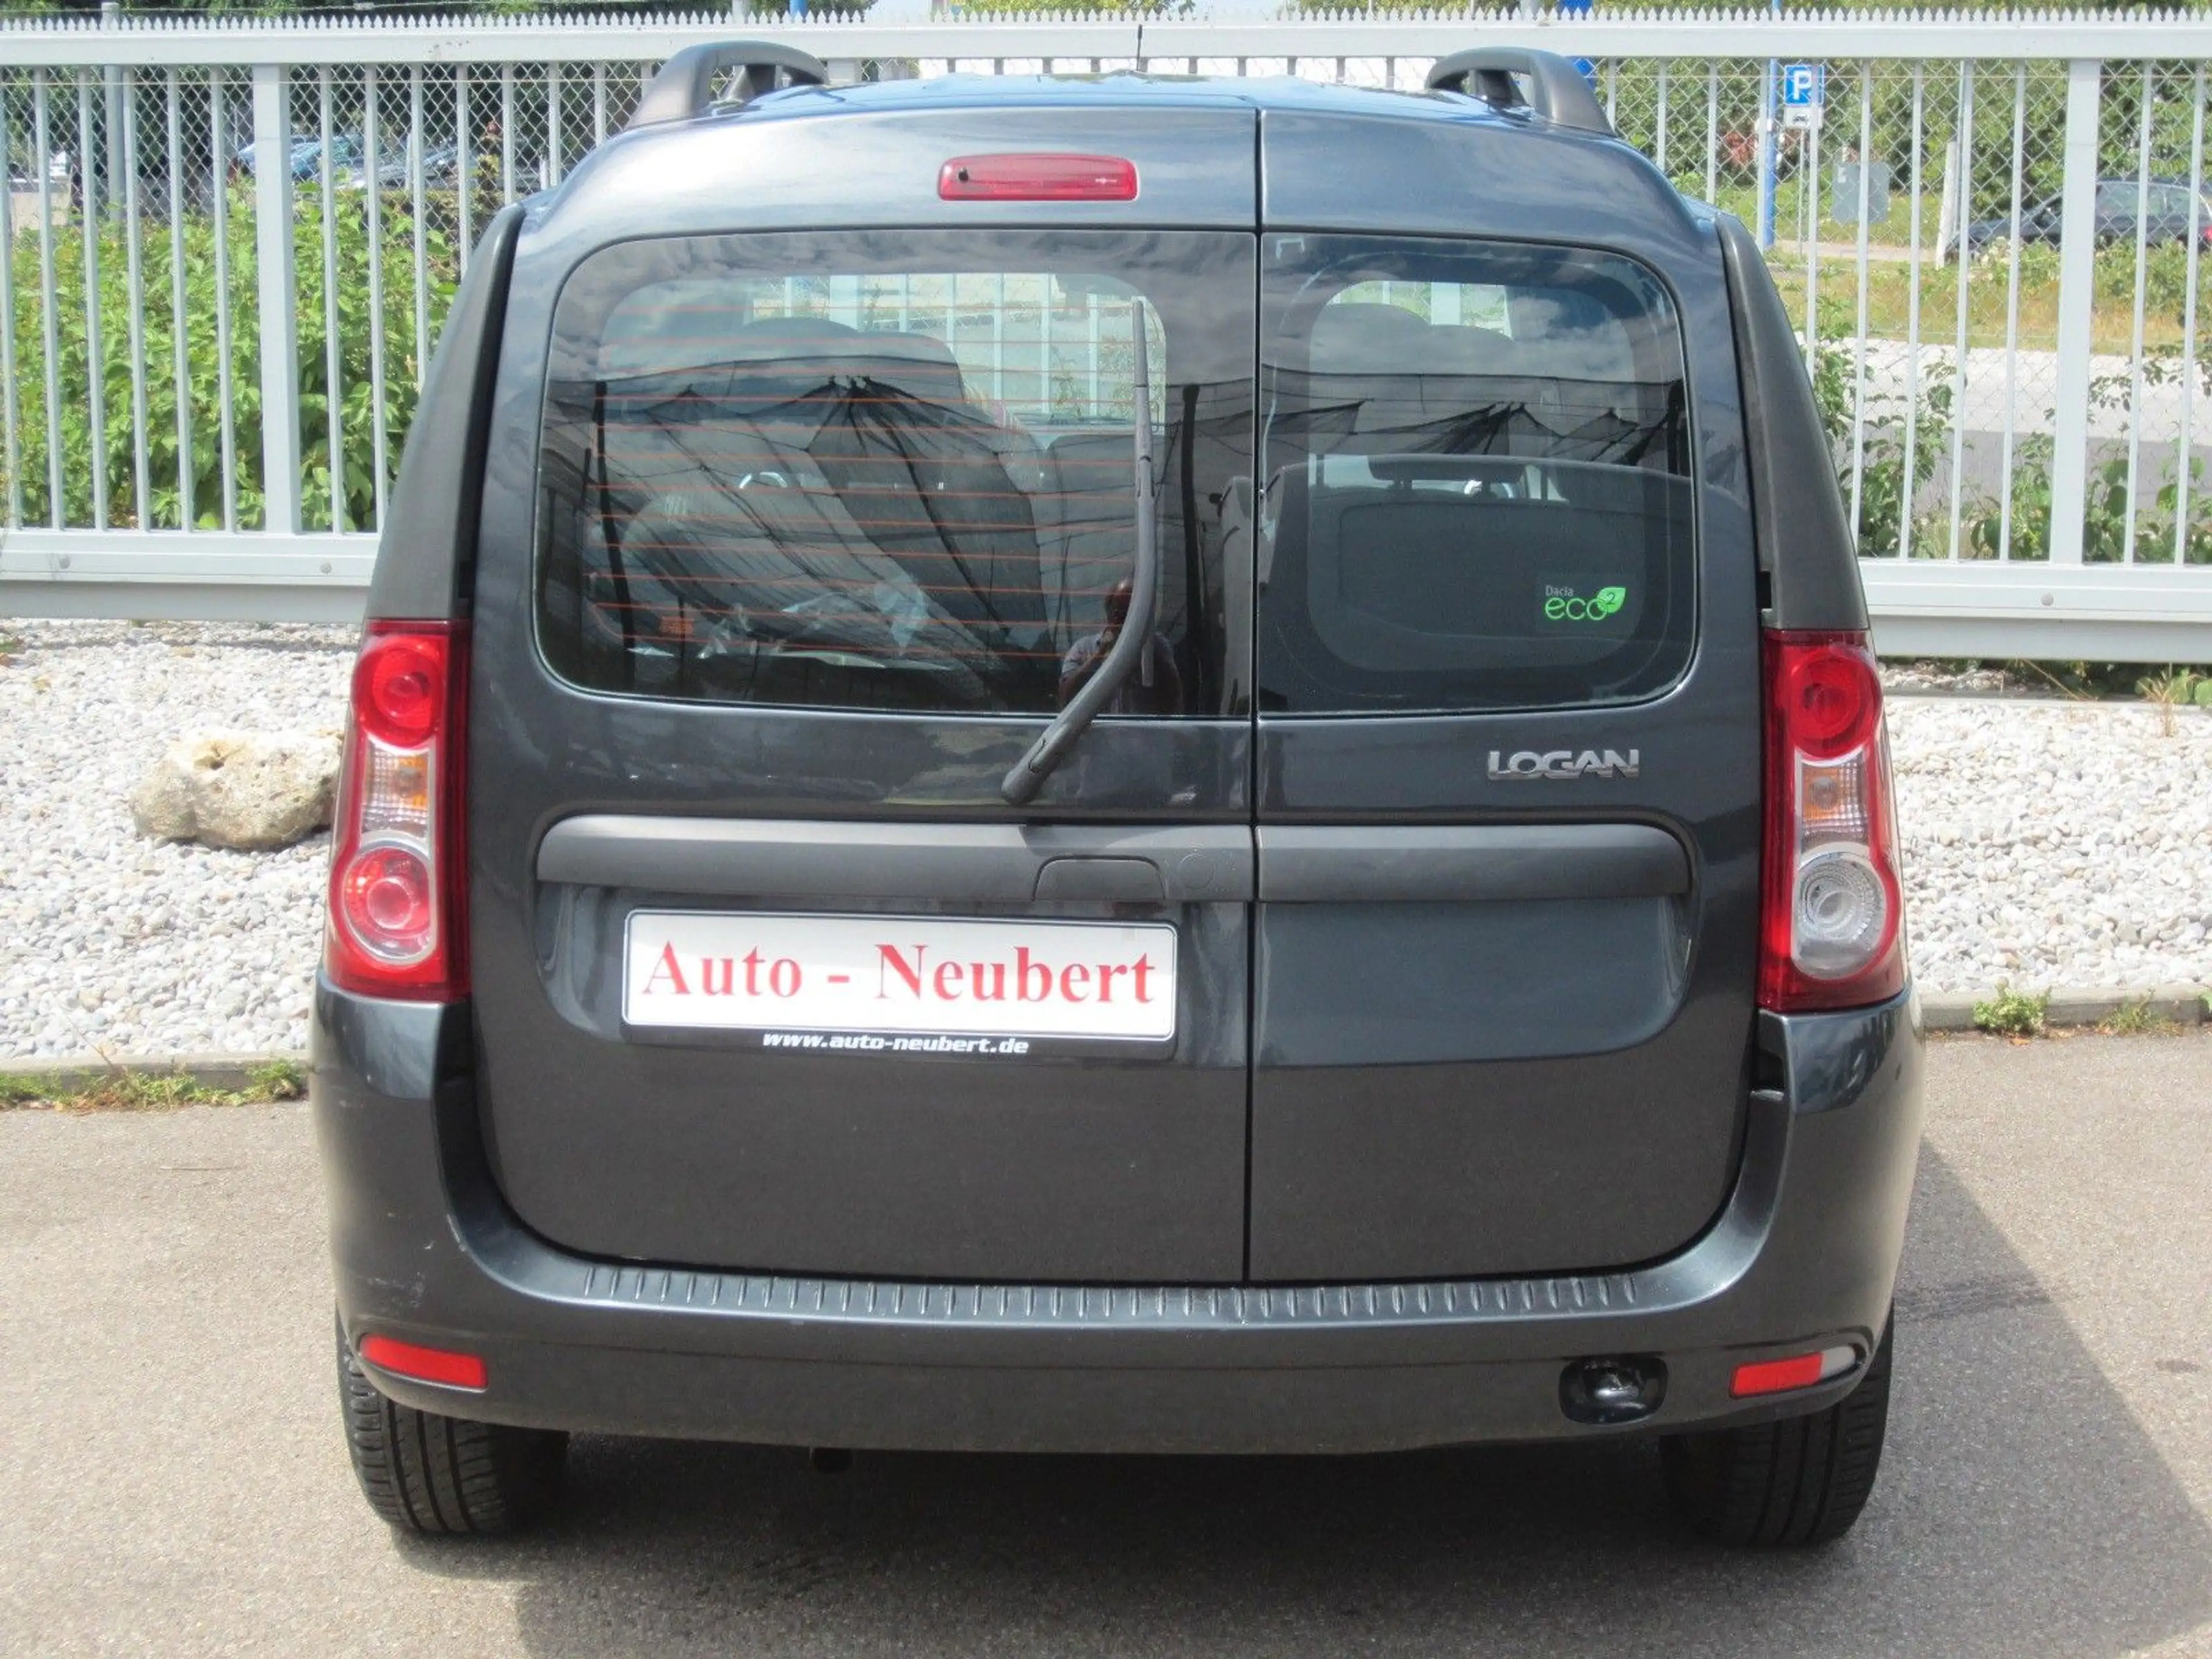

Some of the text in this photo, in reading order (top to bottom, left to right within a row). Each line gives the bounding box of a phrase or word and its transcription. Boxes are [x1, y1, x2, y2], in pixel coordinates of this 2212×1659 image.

[1793, 70, 1812, 100] P
[1545, 585, 1574, 597] Dacia
[1488, 749, 1639, 780] LOGAN
[642, 941, 802, 996] Auto
[873, 943, 1155, 1004] Neubert
[762, 1032, 1029, 1054] www.auto-neubert.de
